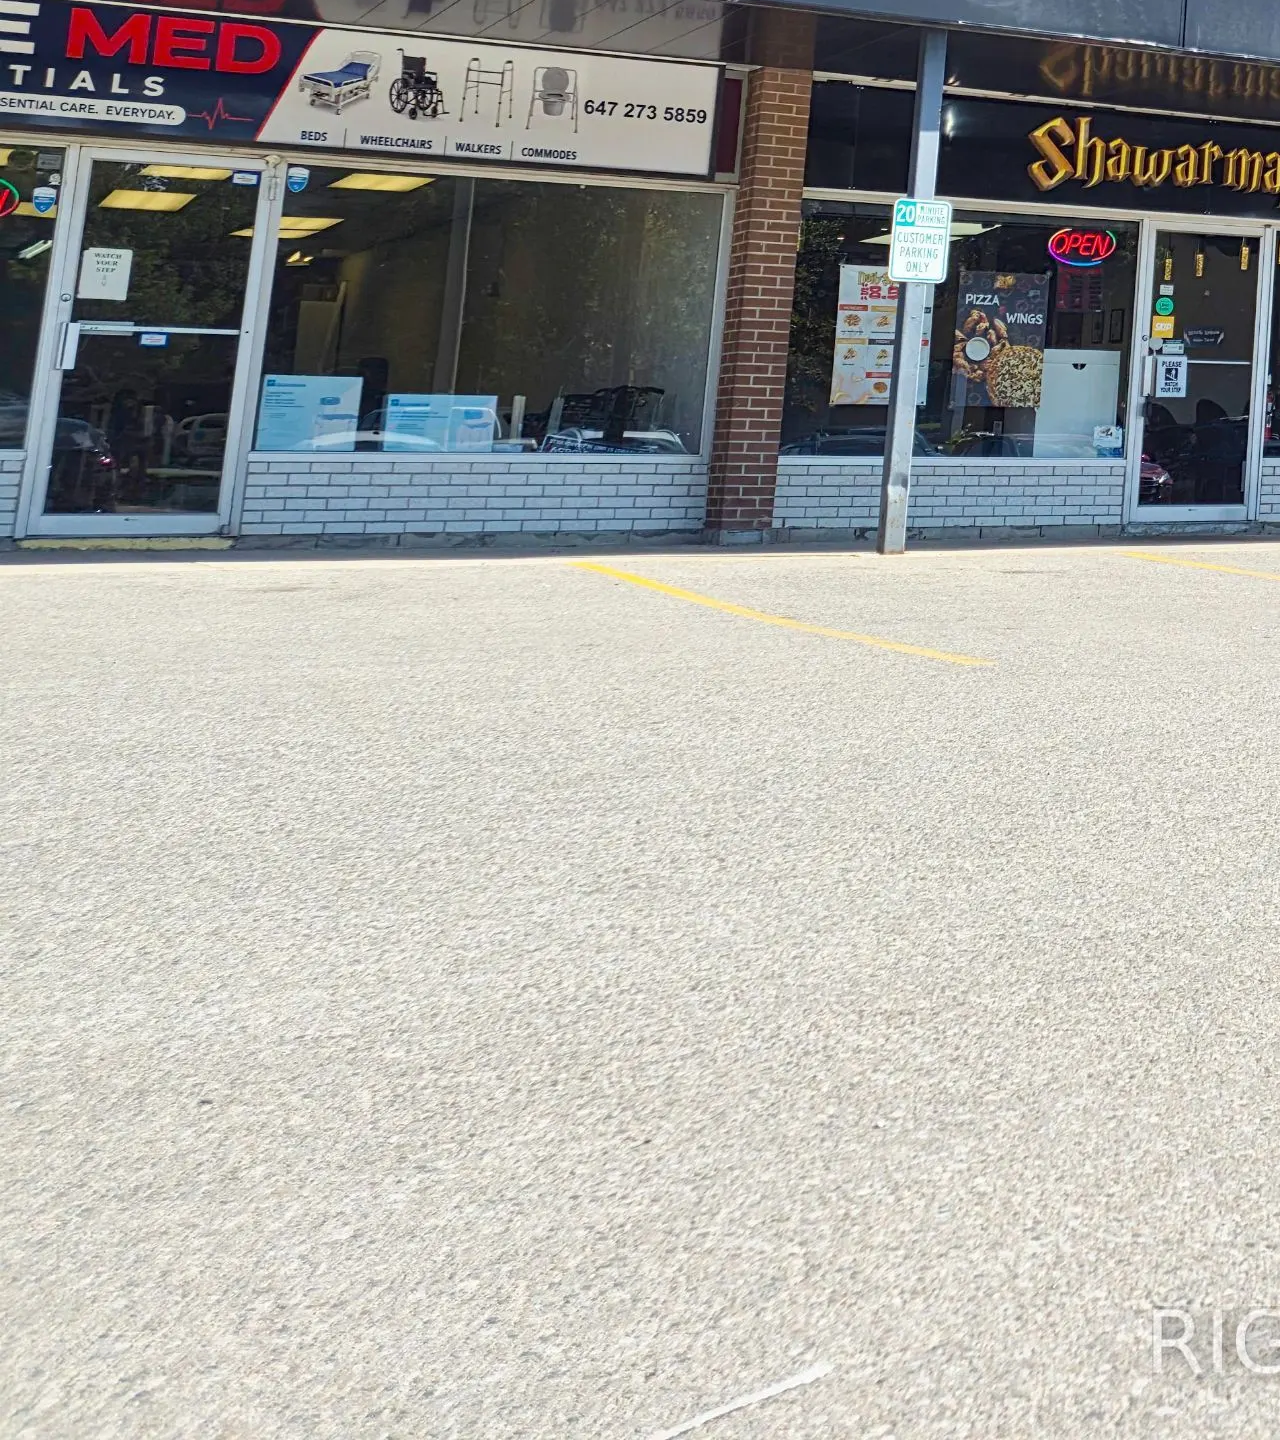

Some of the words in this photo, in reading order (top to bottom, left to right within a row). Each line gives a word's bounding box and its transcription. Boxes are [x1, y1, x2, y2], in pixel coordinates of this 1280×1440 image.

[65, 7, 282, 74] MED
[8, 64, 166, 97] TIALS
[0, 97, 57, 111] SENTIAL
[60, 102, 98, 115] CARE.
[106, 105, 176, 120] EVERYDAY.
[583, 99, 618, 117] 647
[623, 102, 657, 121] 273
[663, 106, 708, 125] 5859
[300, 130, 328, 143] BEDS
[359, 134, 433, 150] WHEELCHAIRS
[455, 141, 502, 156] WALKERS
[521, 146, 577, 161] COMMODES
[896, 204, 915, 223] 20
[919, 205, 945, 215] MINUTE
[917, 215, 946, 225] PARKING
[897, 231, 944, 246] CUSTOMER
[1052, 233, 1111, 256] OPEN
[899, 246, 940, 259] PARKING
[905, 261, 930, 273] ONLY
[965, 293, 1000, 306] PIZZA
[1005, 312, 1044, 325] WINGS
[1161, 360, 1182, 368] PLEASE
